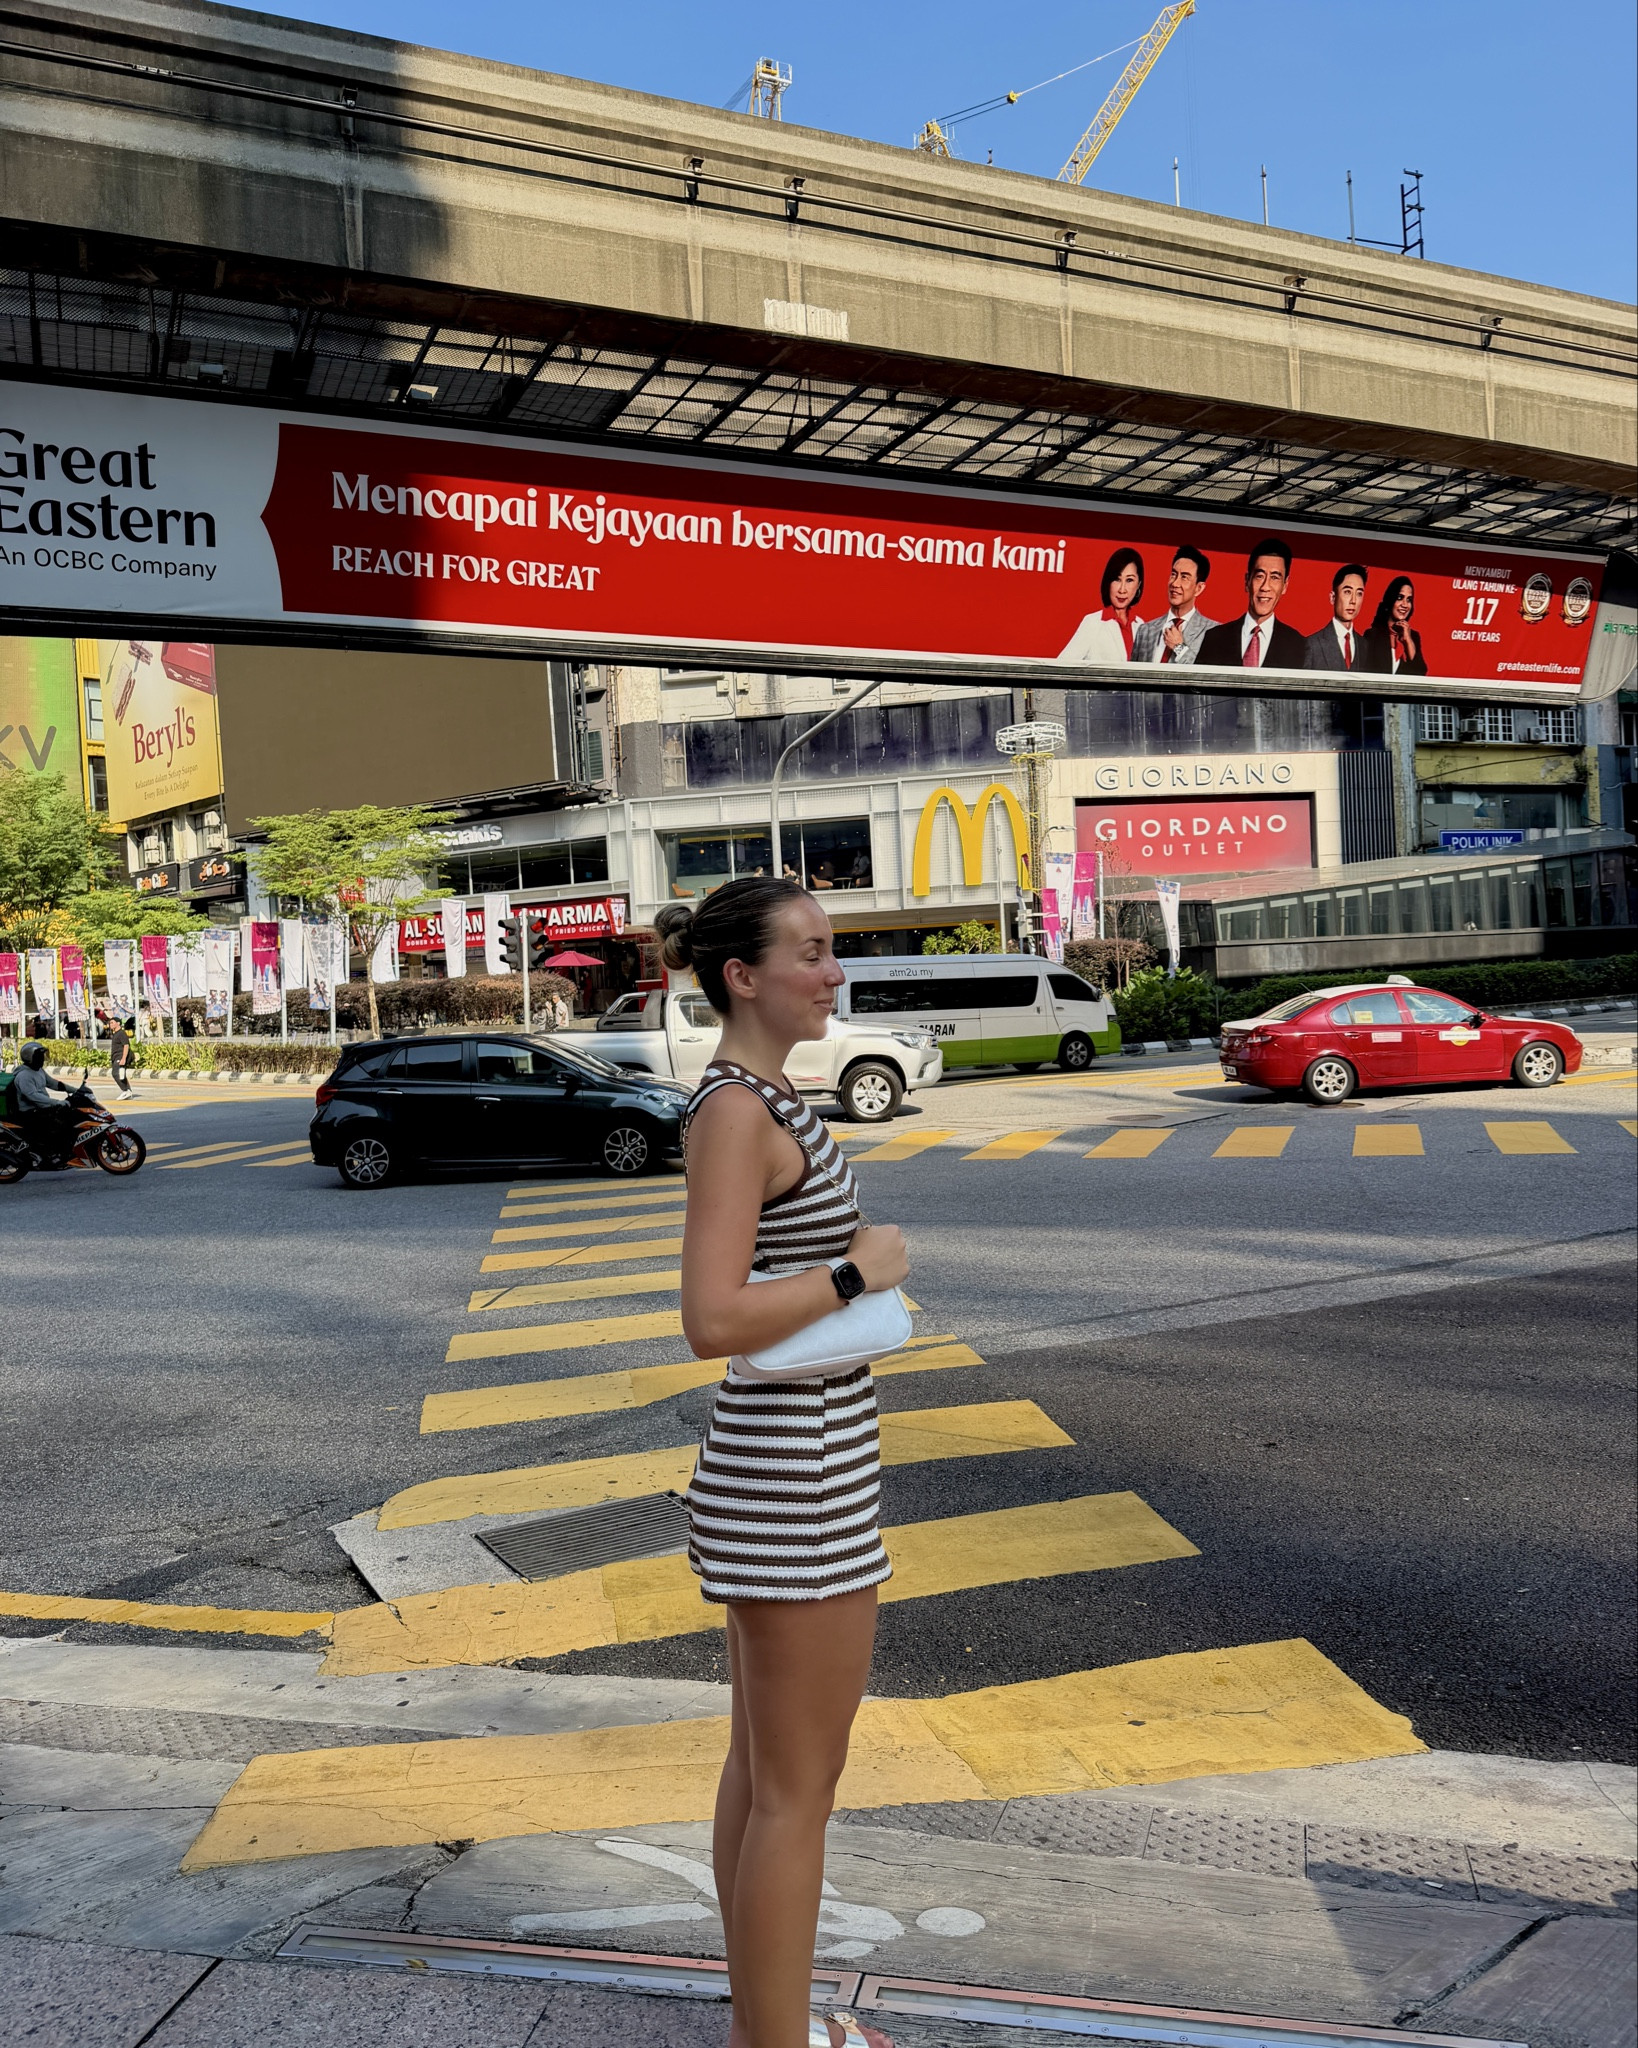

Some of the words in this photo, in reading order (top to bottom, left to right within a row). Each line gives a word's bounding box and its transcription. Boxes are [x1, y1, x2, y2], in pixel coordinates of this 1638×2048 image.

[0, 428, 157, 490] Great
[0, 485, 217, 548] Eastern
[331, 470, 539, 533] Mencapai
[548, 492, 722, 547] Kejayaan
[732, 509, 985, 568] bersama-sama
[991, 536, 1067, 574] kami
[33, 547, 105, 571] OCBC
[111, 553, 217, 581] Company
[331, 544, 435, 579] REACH
[442, 553, 502, 584] FOR
[506, 559, 601, 592] GREAT
[1464, 565, 1512, 579] MENYAMBUT
[1452, 579, 1478, 591] ULANG
[1479, 580, 1505, 593] TAHUN
[1463, 596, 1500, 626] 117
[1451, 629, 1477, 642] GREAT
[1477, 631, 1501, 643] YEARS
[1496, 661, 1581, 675] greateasternlife.com
[132, 705, 196, 768] Beryl's
[1095, 762, 1295, 790] GIORDANO
[1094, 814, 1288, 842] GIORDANO
[1141, 840, 1244, 857] OUTLET
[404, 914, 483, 939] AL-SUAN
[555, 927, 577, 935] FRIED
[578, 924, 611, 933] CHICKEN
[889, 967, 934, 978] atm2u.my
